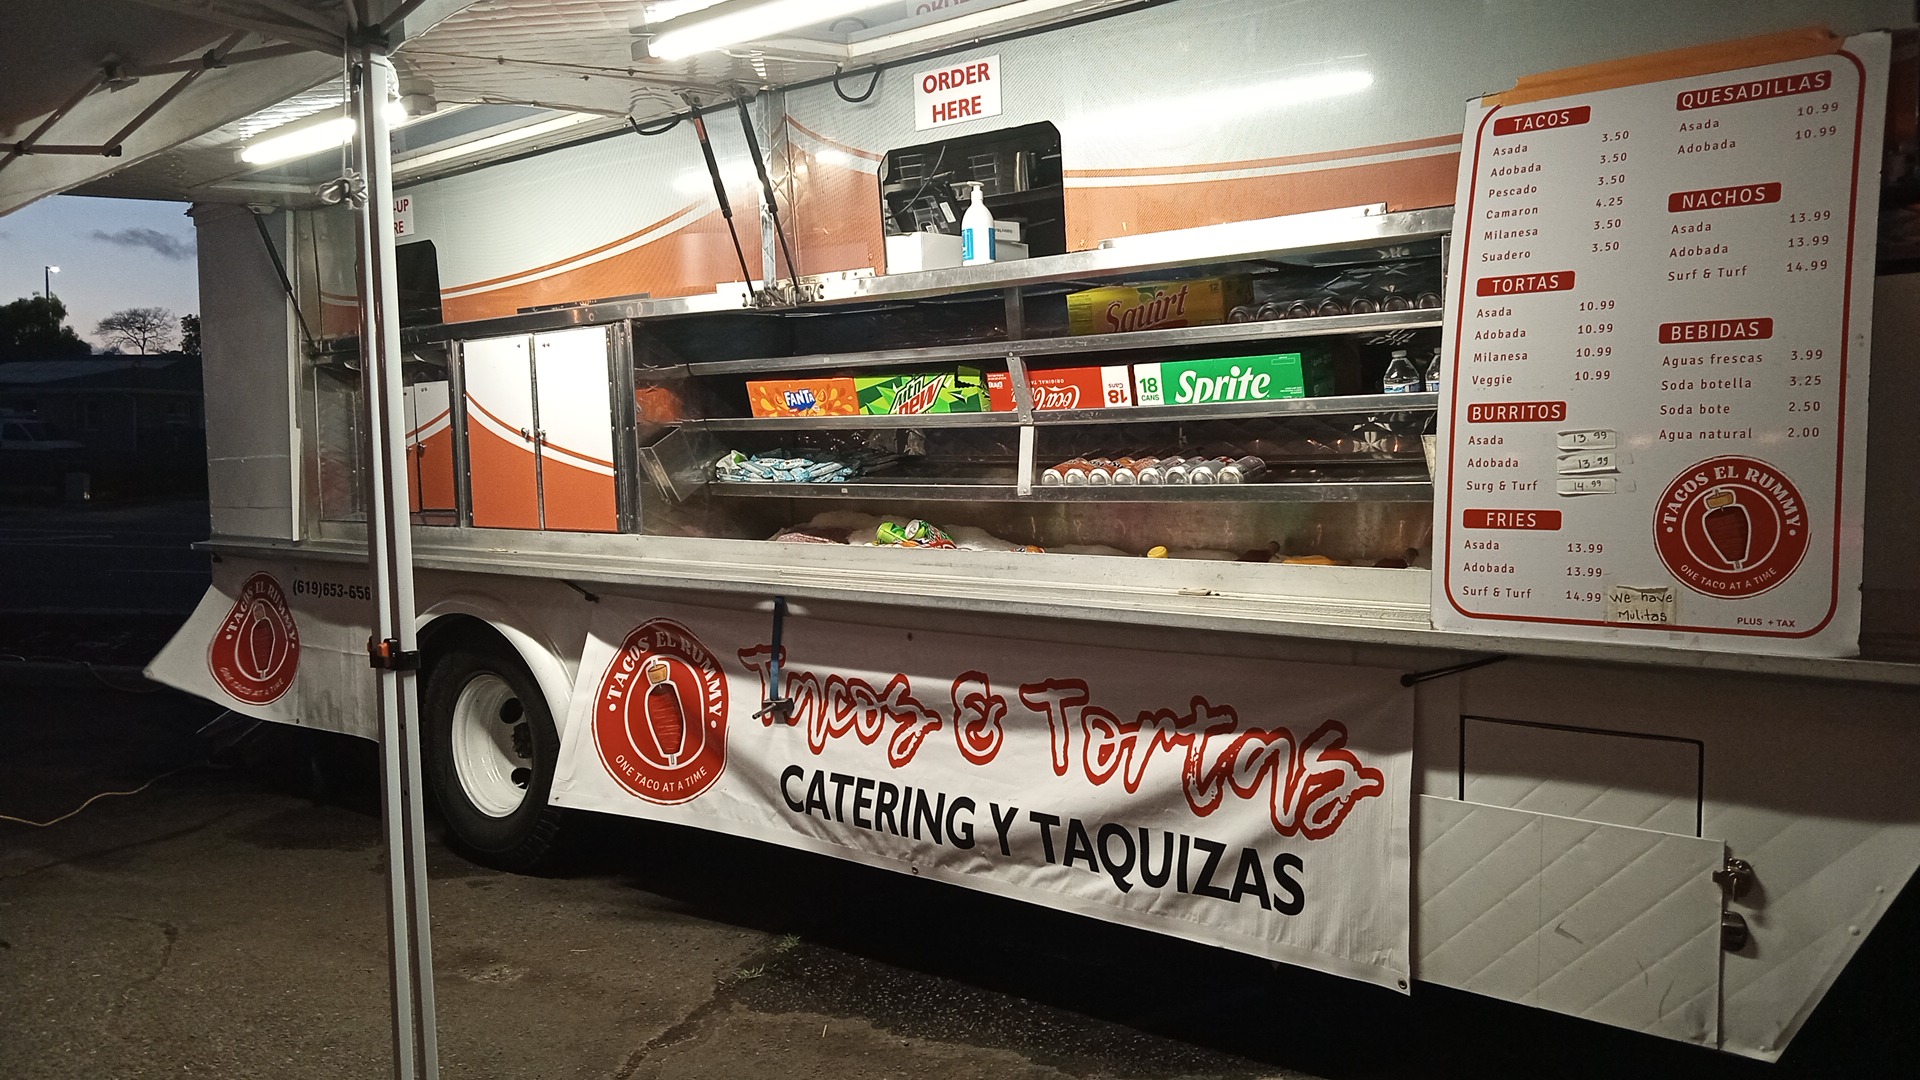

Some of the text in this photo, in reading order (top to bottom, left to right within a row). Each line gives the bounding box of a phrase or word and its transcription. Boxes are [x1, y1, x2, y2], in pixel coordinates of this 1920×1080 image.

[923, 63, 990, 94] ORDER
[1682, 72, 1827, 108] QUESADILLAS
[932, 96, 981, 123] HERE
[1679, 102, 1839, 132] Asada 10.99
[1514, 111, 1569, 131] TACOS
[1493, 130, 1629, 156] Asada 3.50
[1677, 125, 1837, 154] Adobada 10.99
[1490, 152, 1627, 177] Adobada 3.50
[1489, 174, 1625, 198] Pescado 3.50
[1486, 196, 1623, 219] Camaron 4.25
[1682, 187, 1765, 209] NACHOS
[1484, 219, 1621, 240] Milanesa 3.50
[1671, 210, 1830, 234] Asada 13.99
[1482, 241, 1619, 262] Suadero 3.50
[1669, 235, 1829, 258] Adobada 13.99
[1668, 260, 1827, 281] Surf & Turf 14.99
[1492, 275, 1558, 293] TORTAS
[1106, 284, 1189, 333] Squirt
[1476, 300, 1615, 318] Asada 10.99
[1475, 323, 1613, 340] Adobada 10.99
[1671, 322, 1759, 340] BEBIDAS
[1473, 347, 1611, 362] Milanesa 10.99
[1662, 349, 1823, 369] Aguas frescas 3.99
[1140, 378, 1158, 393] 18
[1175, 366, 1270, 404] Sprite
[1472, 370, 1610, 387] Veggie 10.99
[1661, 375, 1821, 391] Soda botella 3.25
[784, 390, 815, 406] FANTA
[1108, 390, 1127, 404] 18
[1473, 404, 1560, 420] BURRITOS
[1660, 401, 1820, 415] Soda bote 2.50
[1468, 435, 1503, 445] Asada
[1659, 427, 1819, 442] Agua natural 2.00
[1467, 458, 1518, 468] Adobada
[1466, 480, 1538, 493] Surg & Turf
[1663, 466, 1800, 526] TACOS EL RUMMY
[1487, 512, 1536, 527] FRIES
[1464, 540, 1603, 553] Asada 13.99
[1463, 562, 1602, 577] Adobada 13.99
[1681, 564, 1777, 590] ONE TACO AT A TIME
[256, 582, 266, 594] EL
[293, 580, 371, 600] (619)653-656
[1463, 586, 1601, 602] Surf & Turf 14.99
[1641, 592, 1673, 602] have
[1737, 617, 1763, 625] PLUS
[1776, 619, 1795, 627] TAX
[607, 632, 723, 717] TACOS EL RUMMY
[738, 643, 1384, 839] Tacos & Tortas
[616, 754, 707, 792] ONE TACO AT A TIME
[780, 765, 1305, 915] CATERING Y TAQUIZAS
